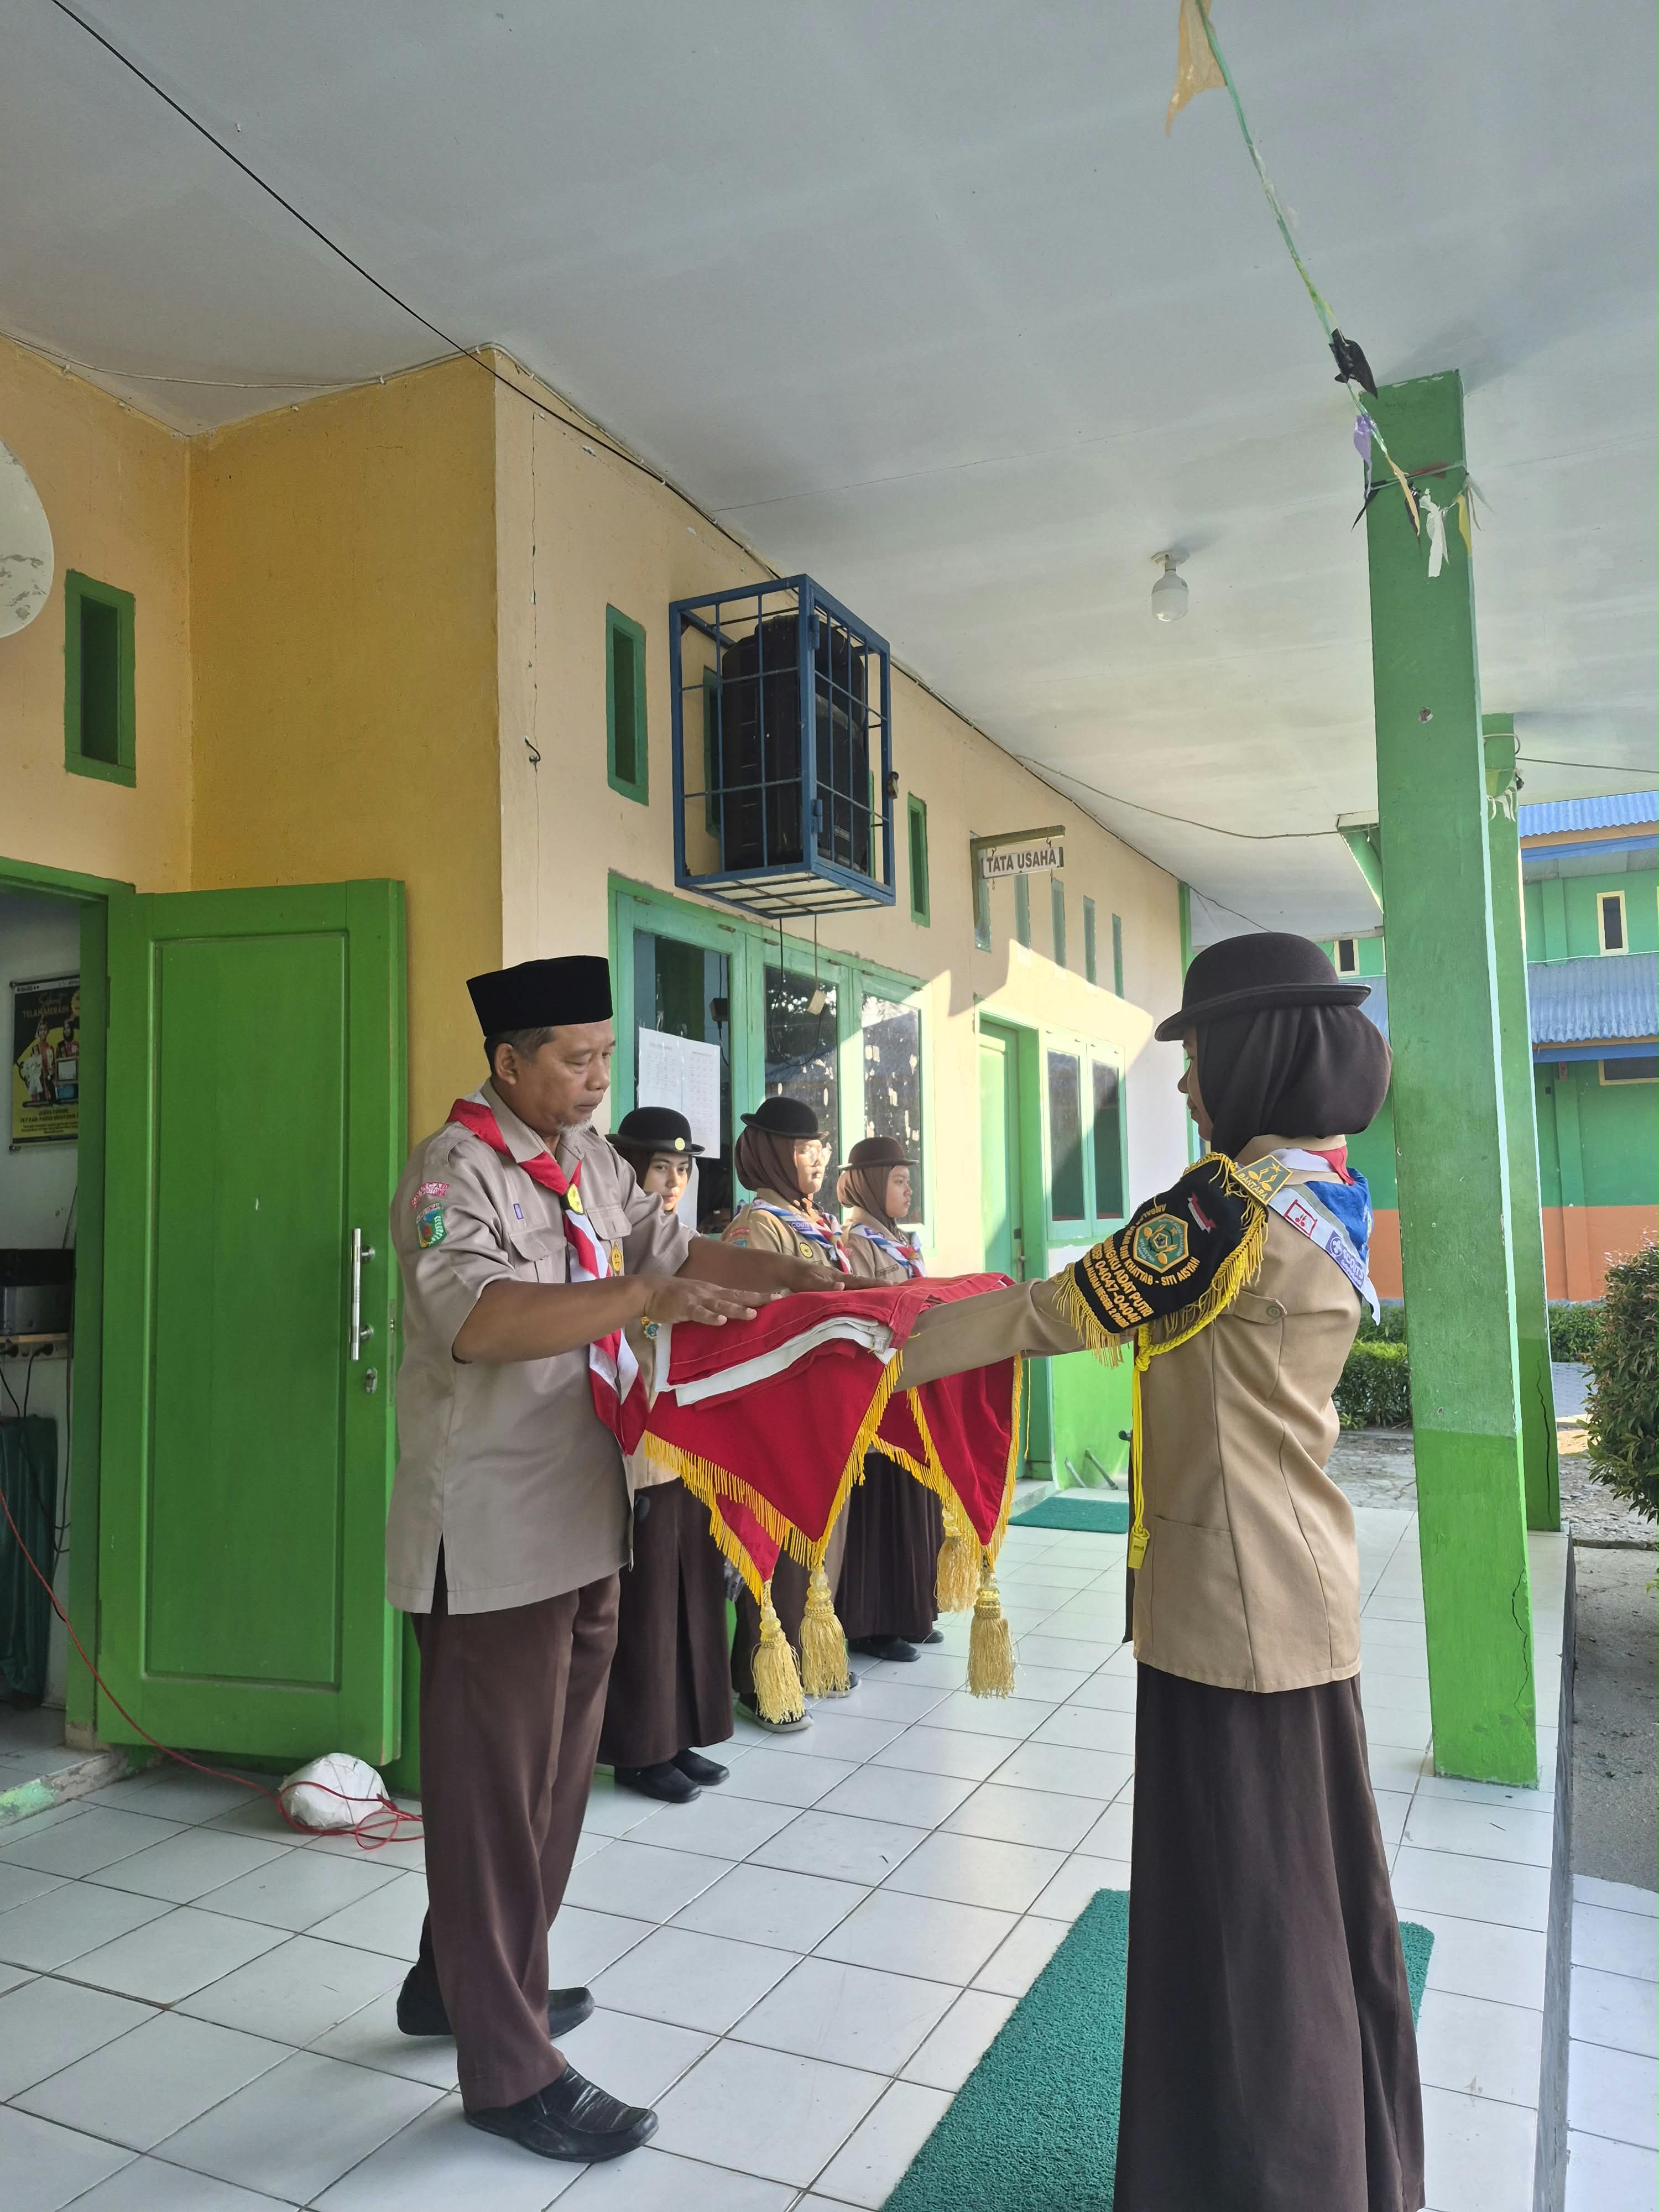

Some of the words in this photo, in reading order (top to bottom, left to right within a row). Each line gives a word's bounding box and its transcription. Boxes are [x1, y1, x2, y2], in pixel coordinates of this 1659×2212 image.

[987, 855, 1014, 873] TATA
[1018, 849, 1056, 869] USAHA
[1238, 1173, 1267, 1199] BANTARA
[1124, 1259, 1153, 1285] KHATTAB
[1161, 1275, 1177, 1286] SITI
[1176, 1256, 1201, 1282] AISYAH
[1095, 1286, 1114, 1311] NEGERI
[1114, 1269, 1136, 1294] ADAT
[1129, 1292, 1154, 1317] PUTRI
